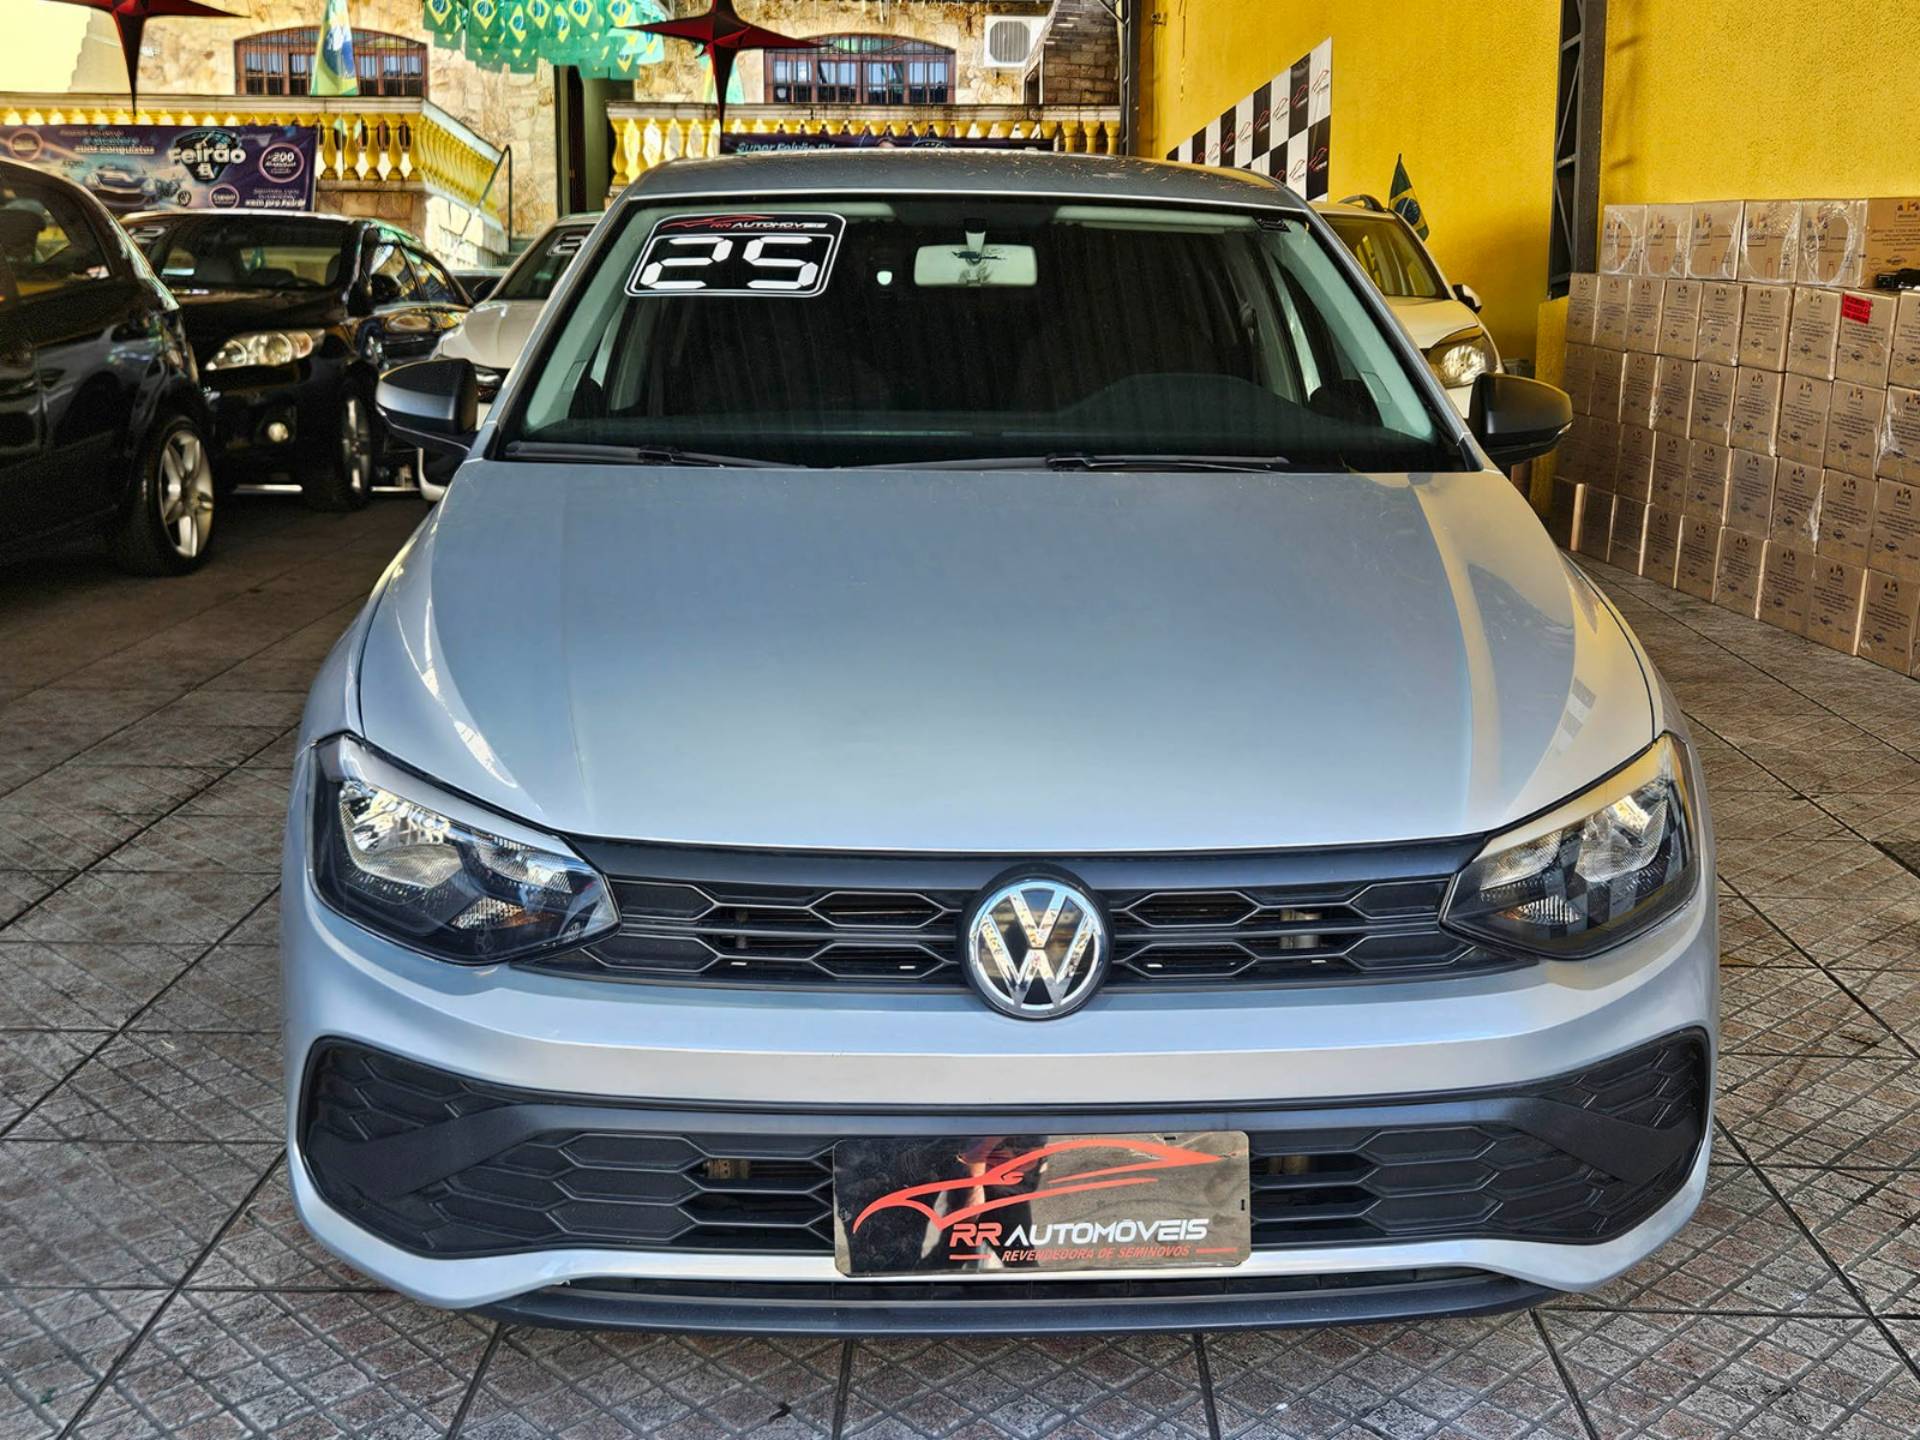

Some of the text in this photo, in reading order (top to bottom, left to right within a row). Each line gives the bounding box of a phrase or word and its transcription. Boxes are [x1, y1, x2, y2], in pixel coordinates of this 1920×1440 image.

[167, 141, 247, 164] Feirão
[640, 236, 819, 290] 25
[949, 1223, 1003, 1248] RR
[1001, 1245, 1191, 1263] REVENDEDORA DE SEMINOVOS
